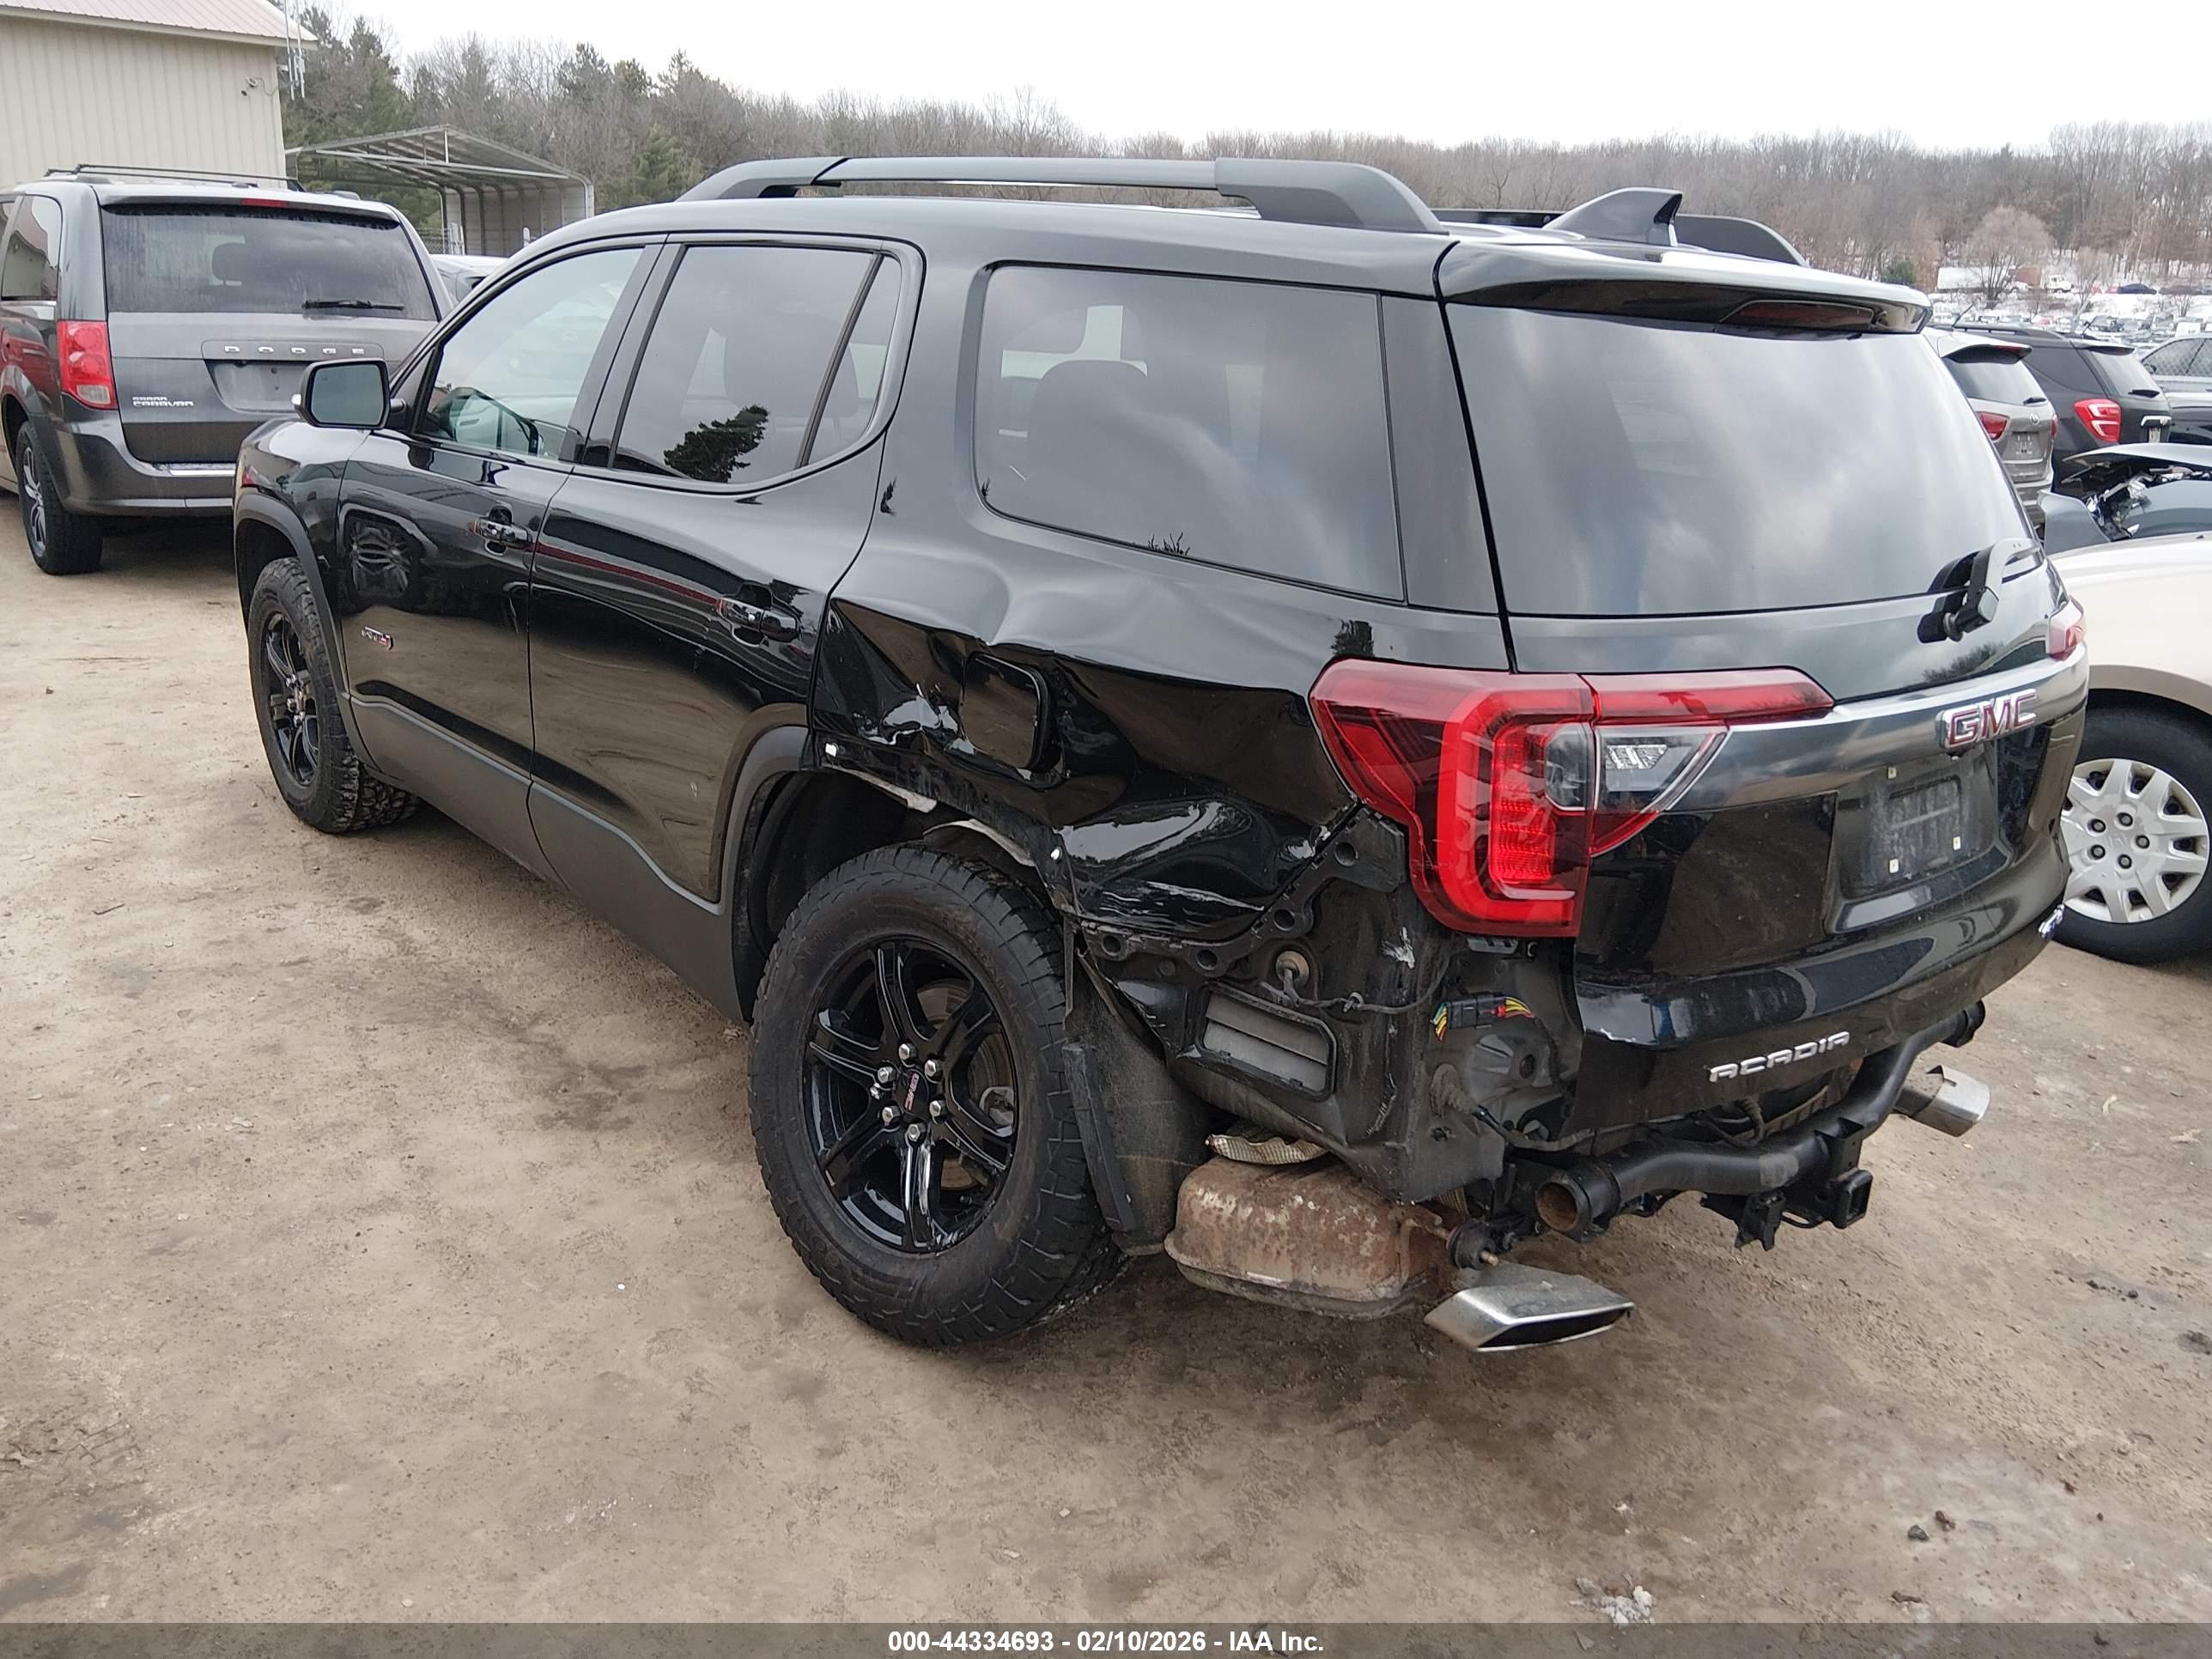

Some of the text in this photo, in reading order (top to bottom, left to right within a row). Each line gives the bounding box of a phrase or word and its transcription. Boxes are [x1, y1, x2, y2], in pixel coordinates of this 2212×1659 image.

[224, 345, 365, 356] DODGE
[1943, 688, 2037, 749] GMC
[1709, 1030, 1850, 1083] ACADIA
